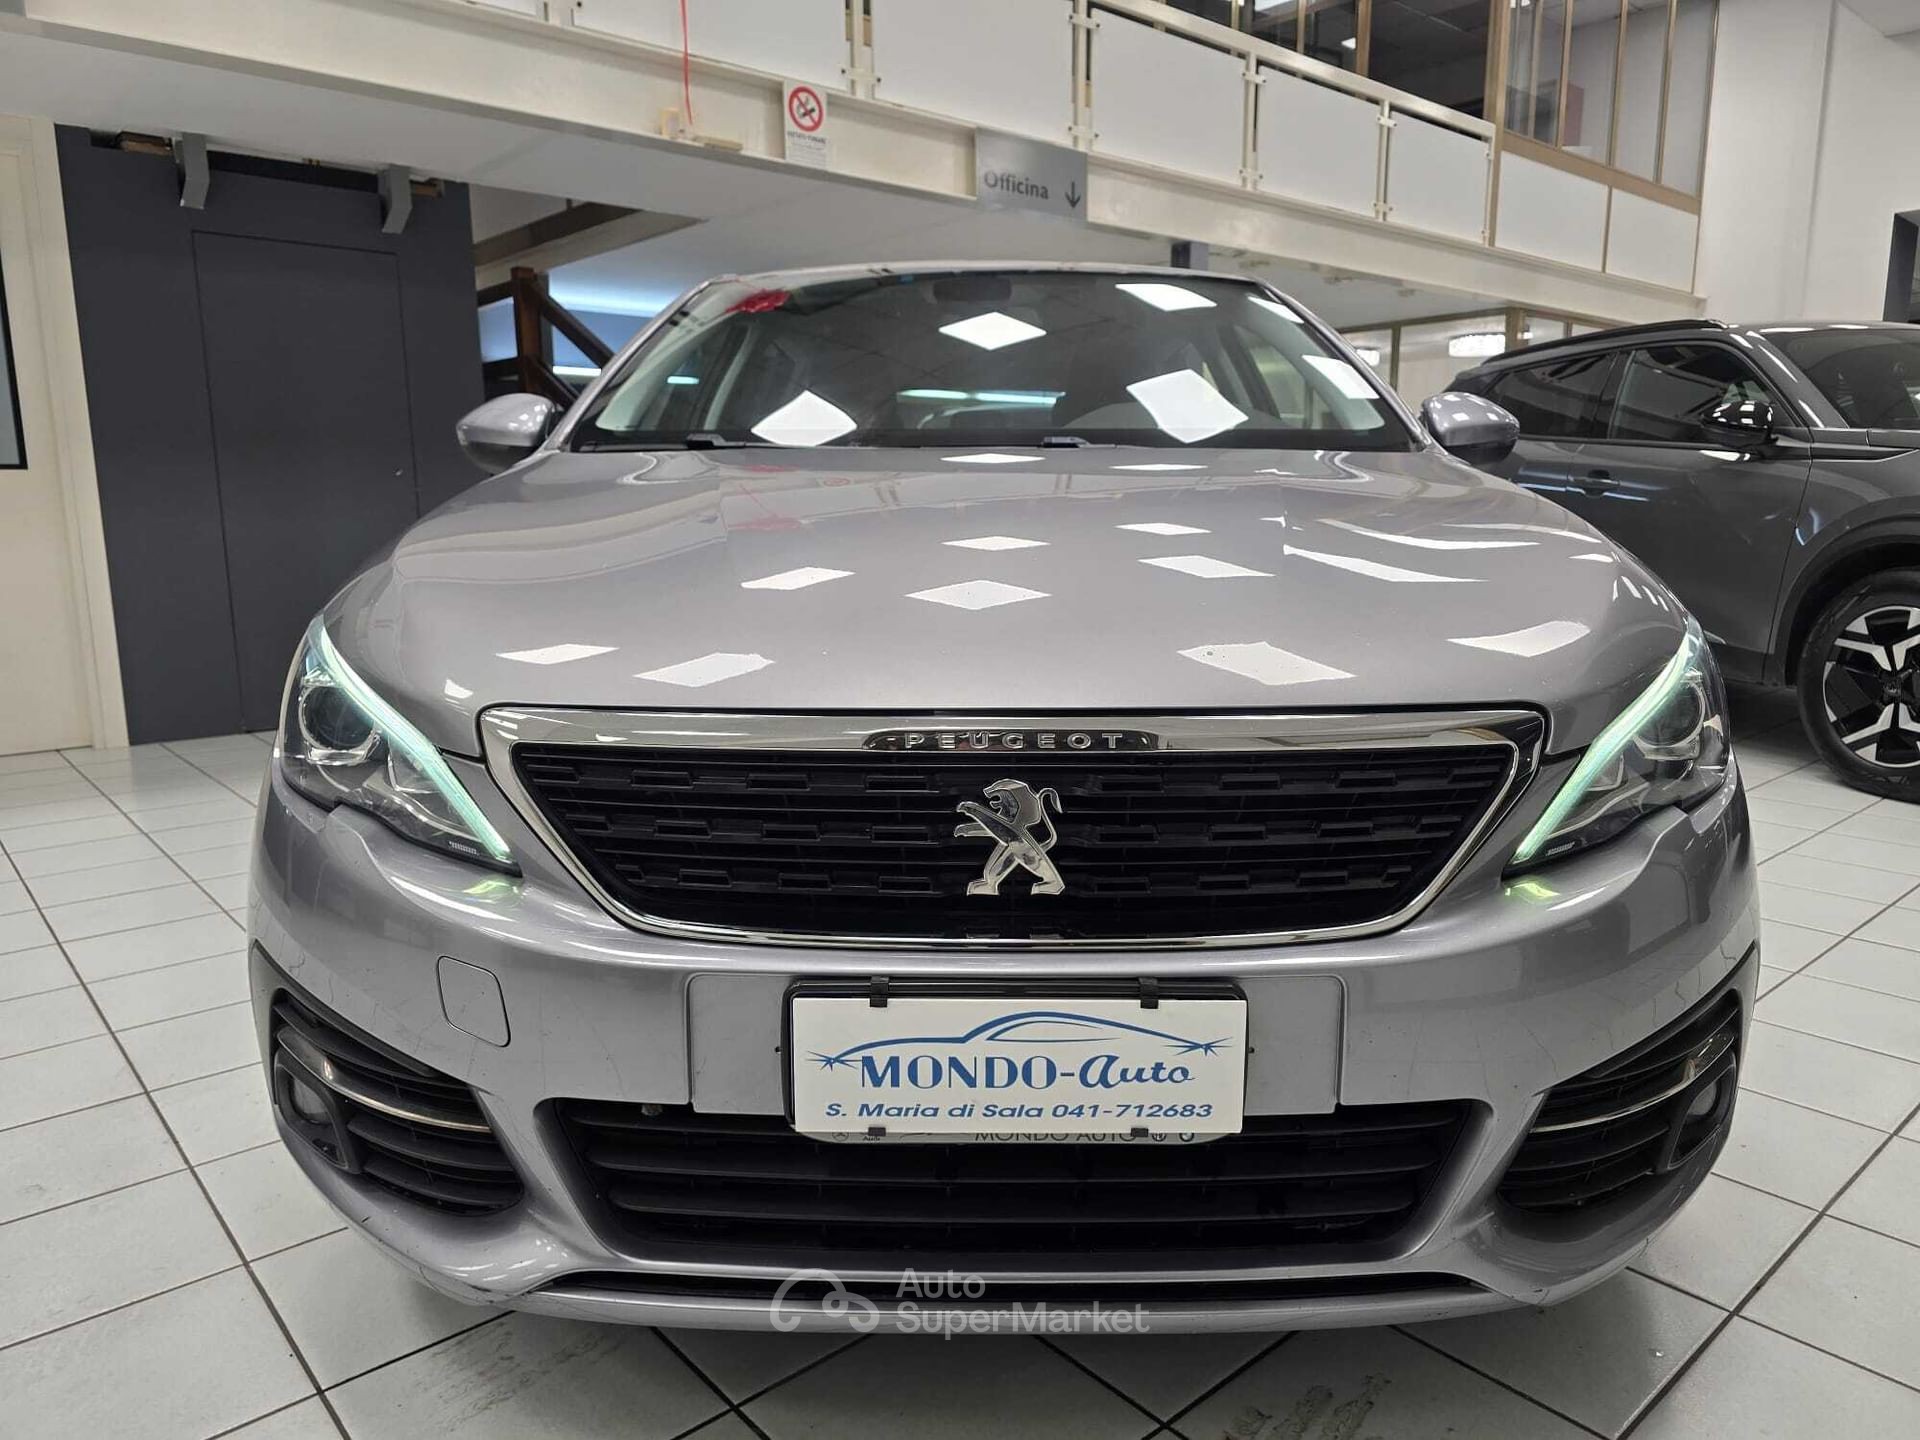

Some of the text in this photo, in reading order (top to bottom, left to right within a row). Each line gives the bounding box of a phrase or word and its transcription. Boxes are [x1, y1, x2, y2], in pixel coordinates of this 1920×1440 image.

[984, 170, 1049, 200] Officina
[904, 731, 1123, 749] PEUGEOT
[861, 1054, 1195, 1089] MONDO-Auto
[825, 1103, 1213, 1119] S. Maria di Sala 041-712683
